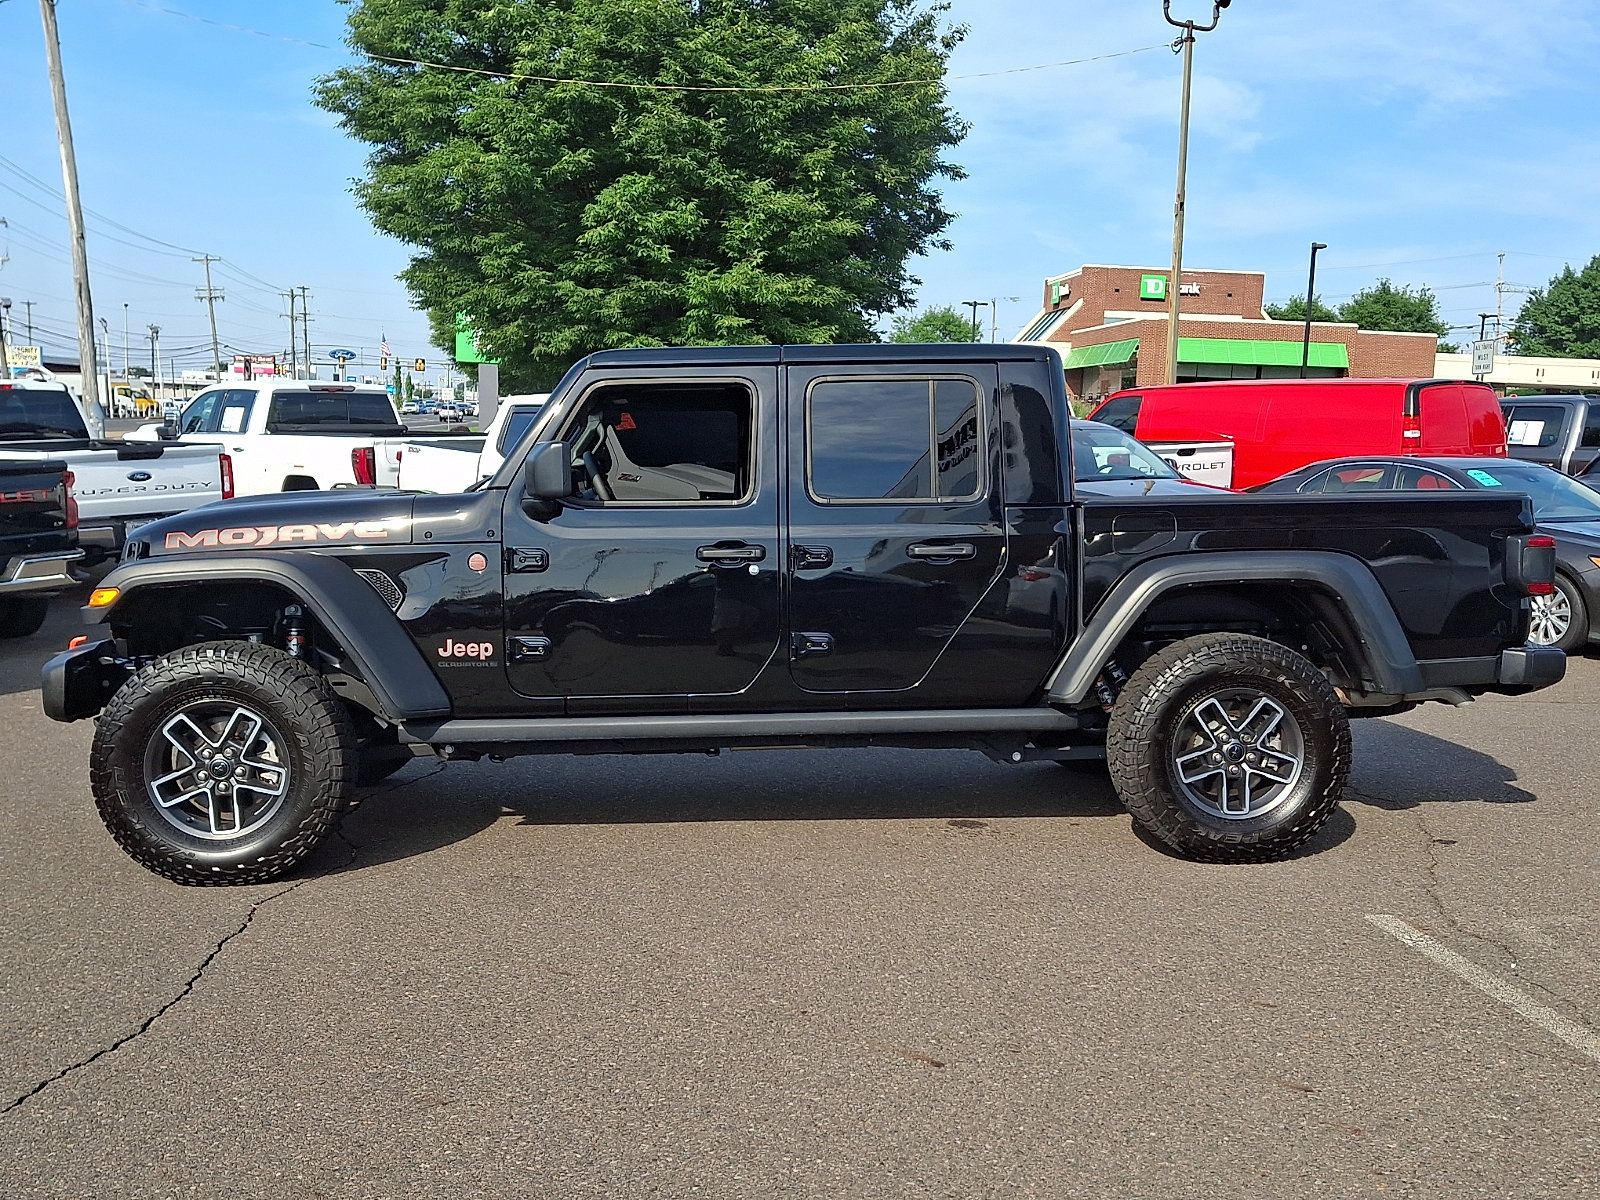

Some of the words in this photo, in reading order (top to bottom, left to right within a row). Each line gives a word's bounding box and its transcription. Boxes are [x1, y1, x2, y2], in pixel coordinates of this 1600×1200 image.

[1145, 279, 1164, 294] TD
[1168, 282, 1200, 294] ank
[155, 481, 212, 491] DUTY
[165, 522, 388, 549] MOJAVE
[437, 638, 493, 660] Jeep
